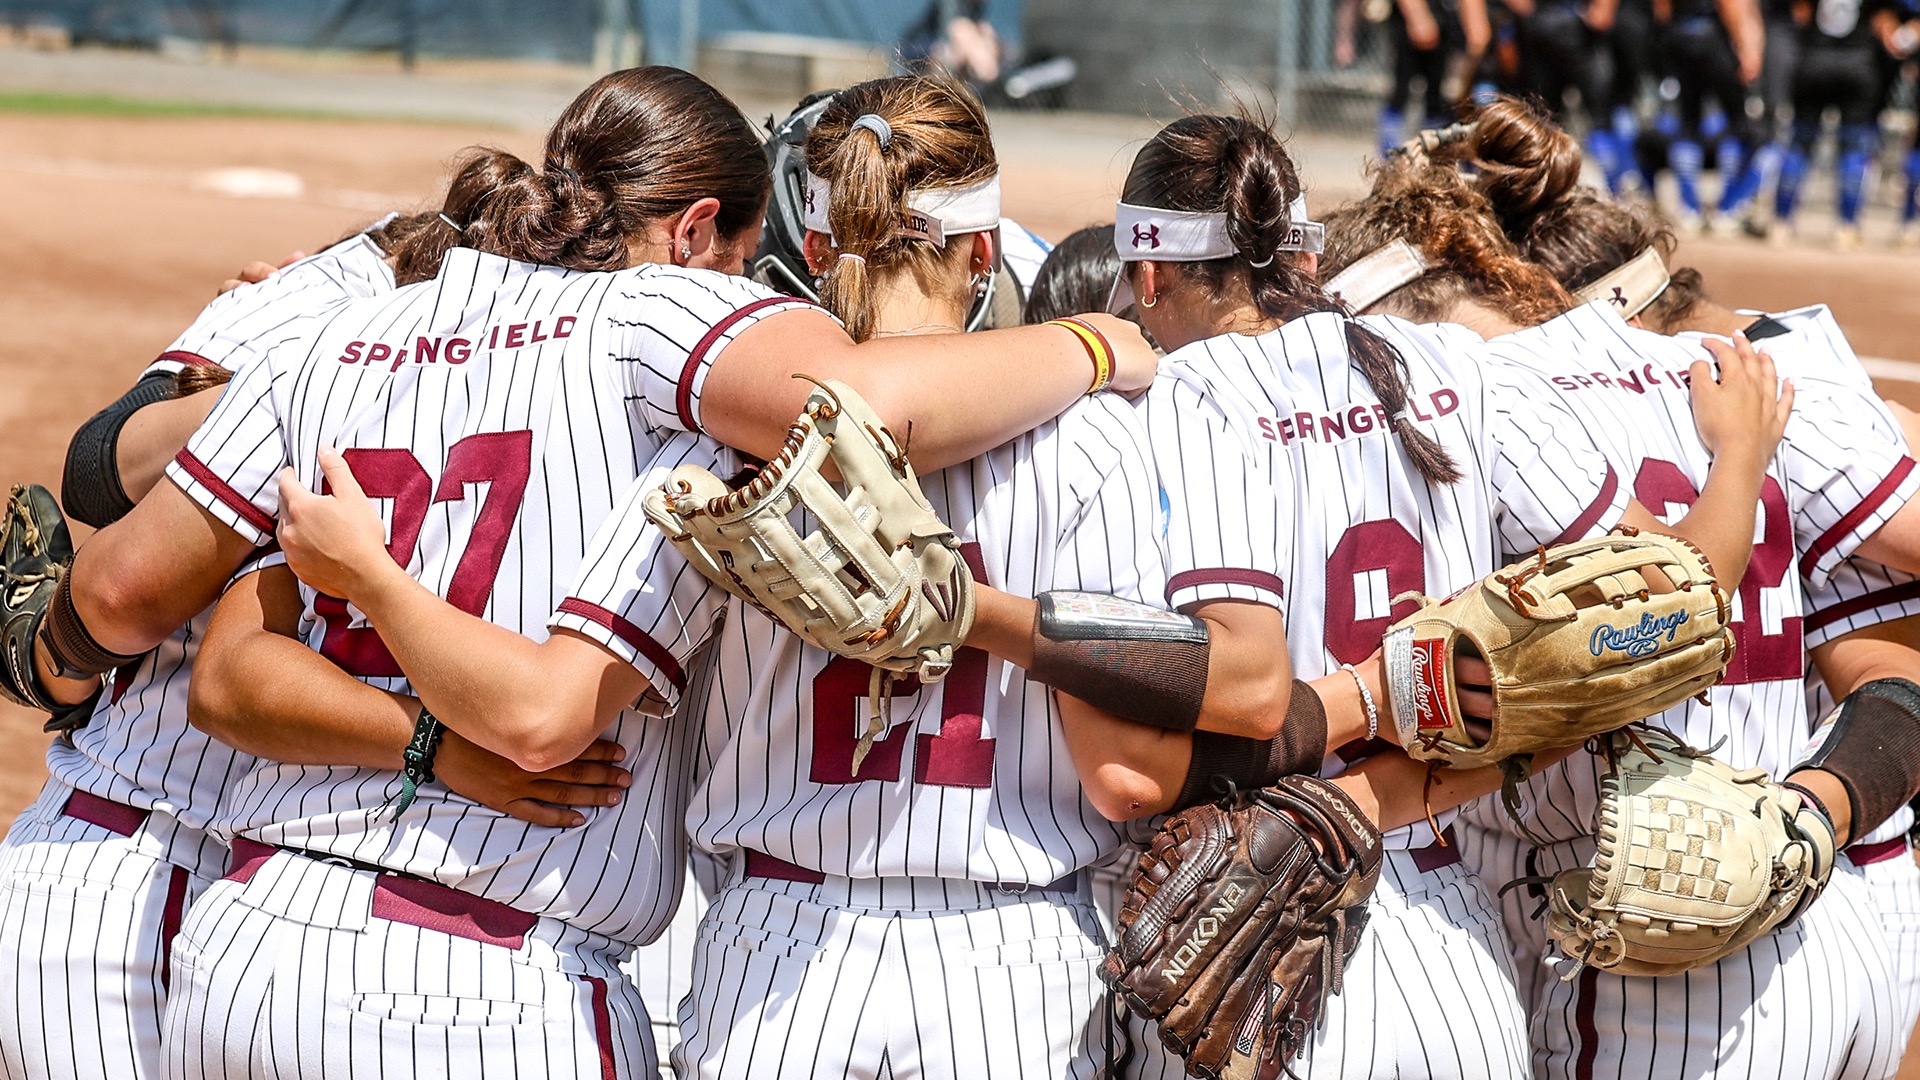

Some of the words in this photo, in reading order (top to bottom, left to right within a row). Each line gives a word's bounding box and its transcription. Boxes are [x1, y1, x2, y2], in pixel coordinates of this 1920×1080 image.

[338, 315, 577, 373] SPNGIELD
[1551, 363, 1691, 395] SPRNGIE
[1257, 388, 1460, 446] SPRNGFLD
[314, 429, 533, 678] 27
[809, 541, 997, 789] 21
[1590, 608, 1690, 657] Rawlings
[1412, 646, 1435, 721] Rawlings
[1301, 780, 1376, 850] NOKONA
[1161, 882, 1247, 985] NOKONA
